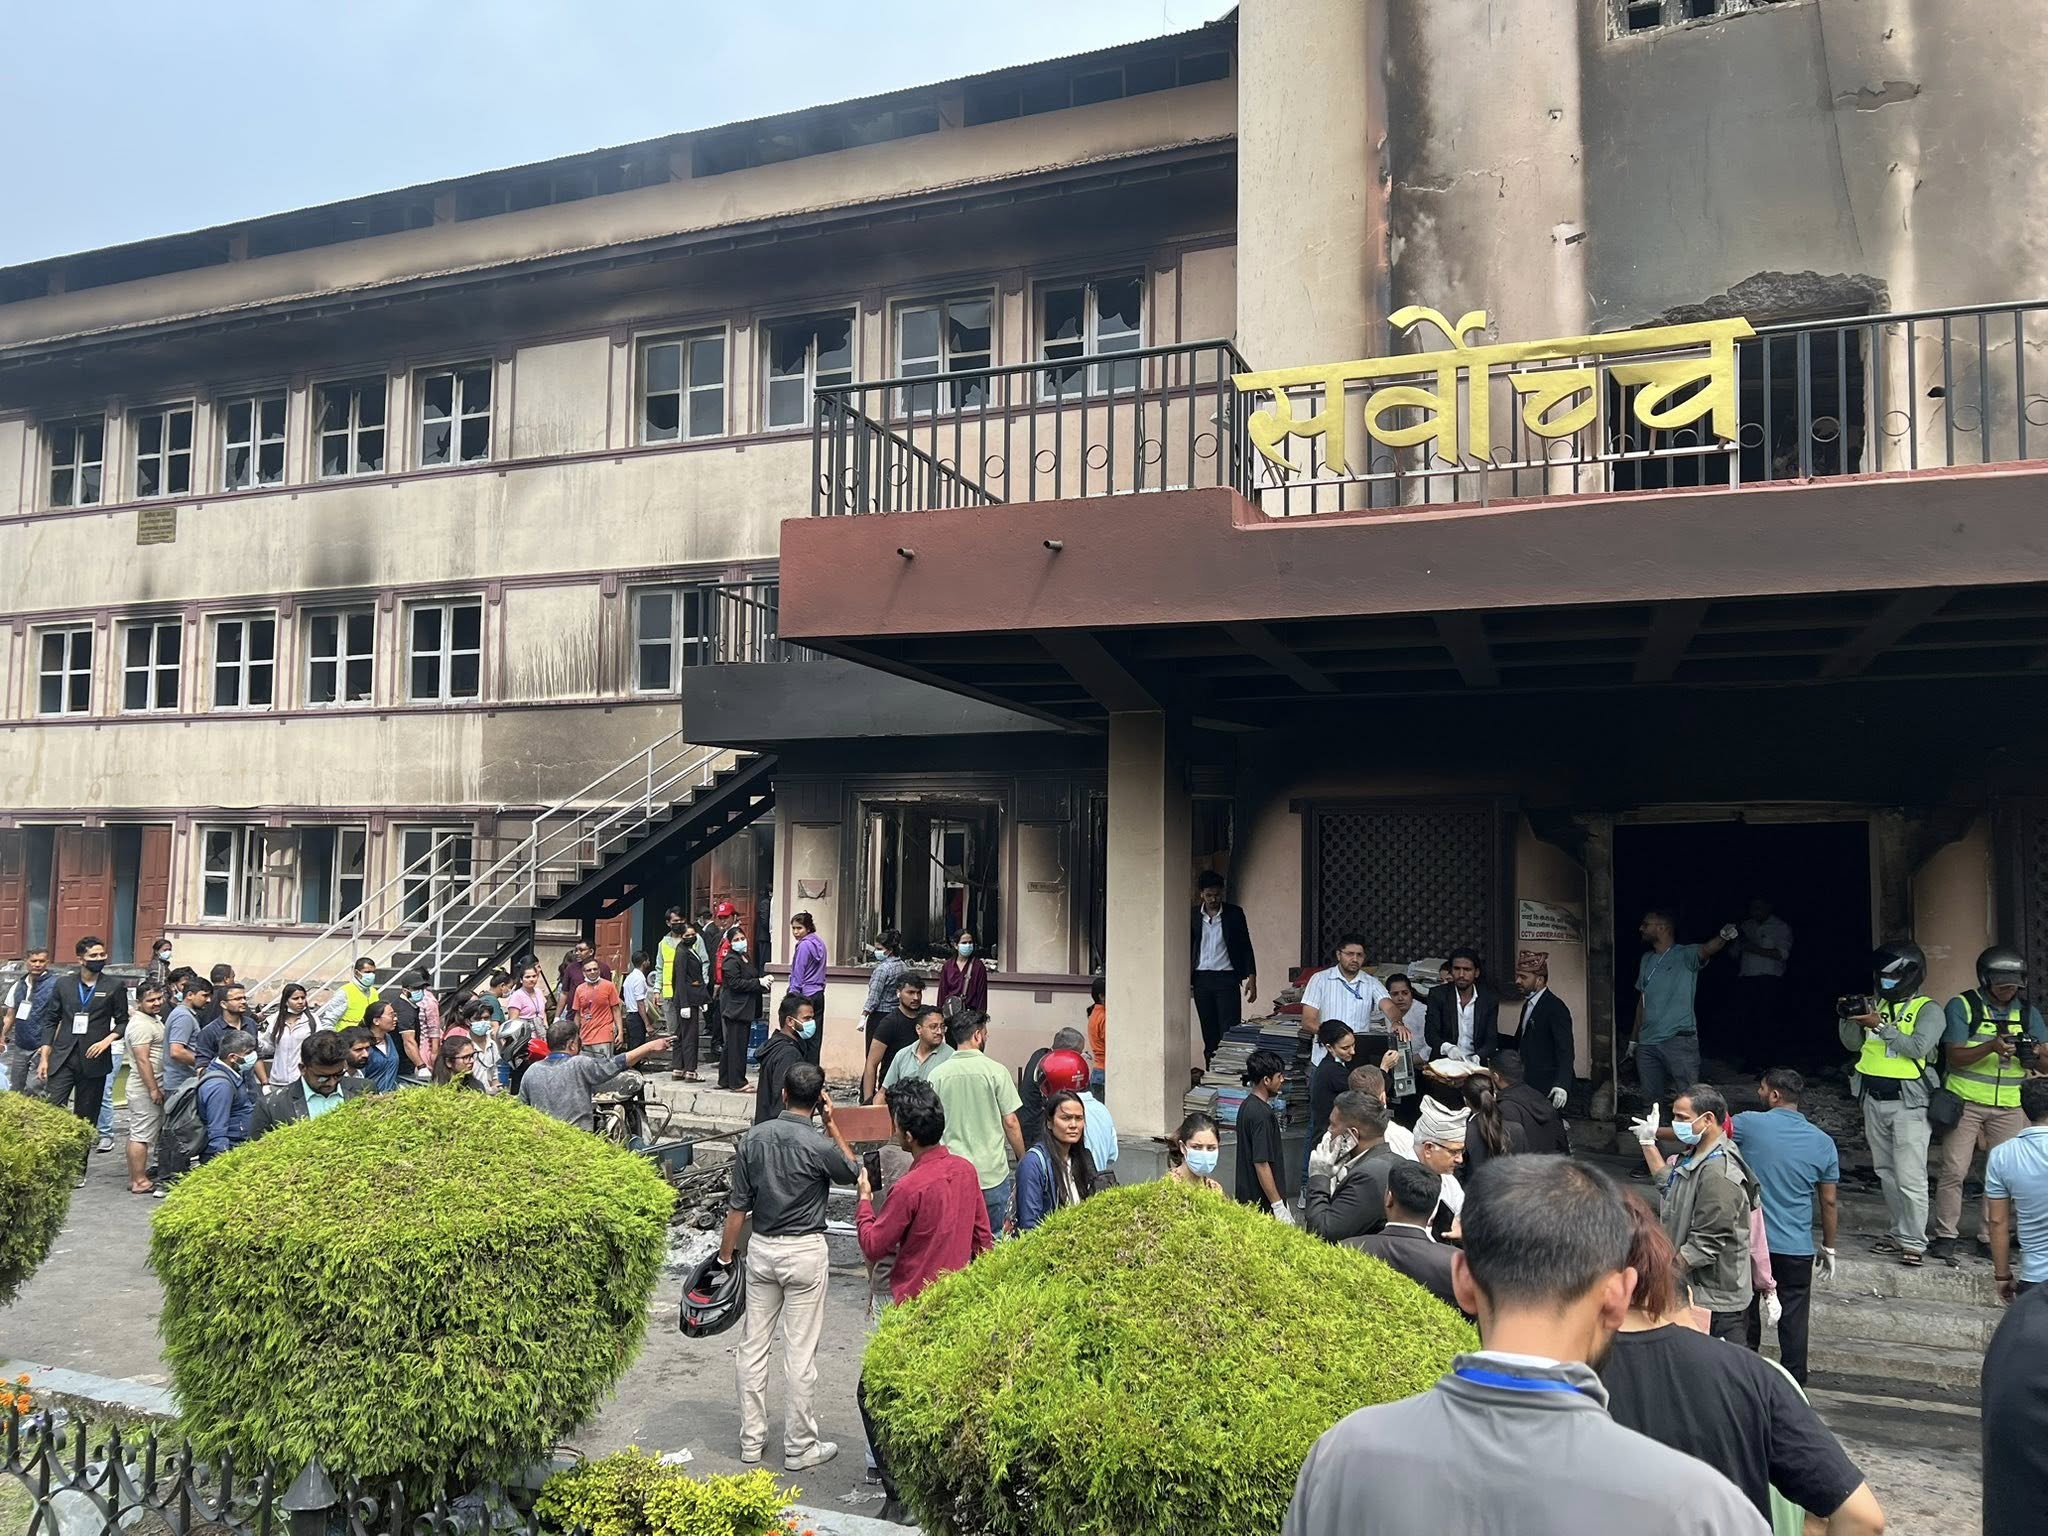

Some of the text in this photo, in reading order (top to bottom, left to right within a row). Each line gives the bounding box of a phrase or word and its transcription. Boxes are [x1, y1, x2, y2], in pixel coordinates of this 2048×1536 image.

[1231, 305, 1755, 476] सर्वोच्च
[1521, 930, 1535, 938] CCTV
[1536, 931, 1564, 939] COVERAGE
